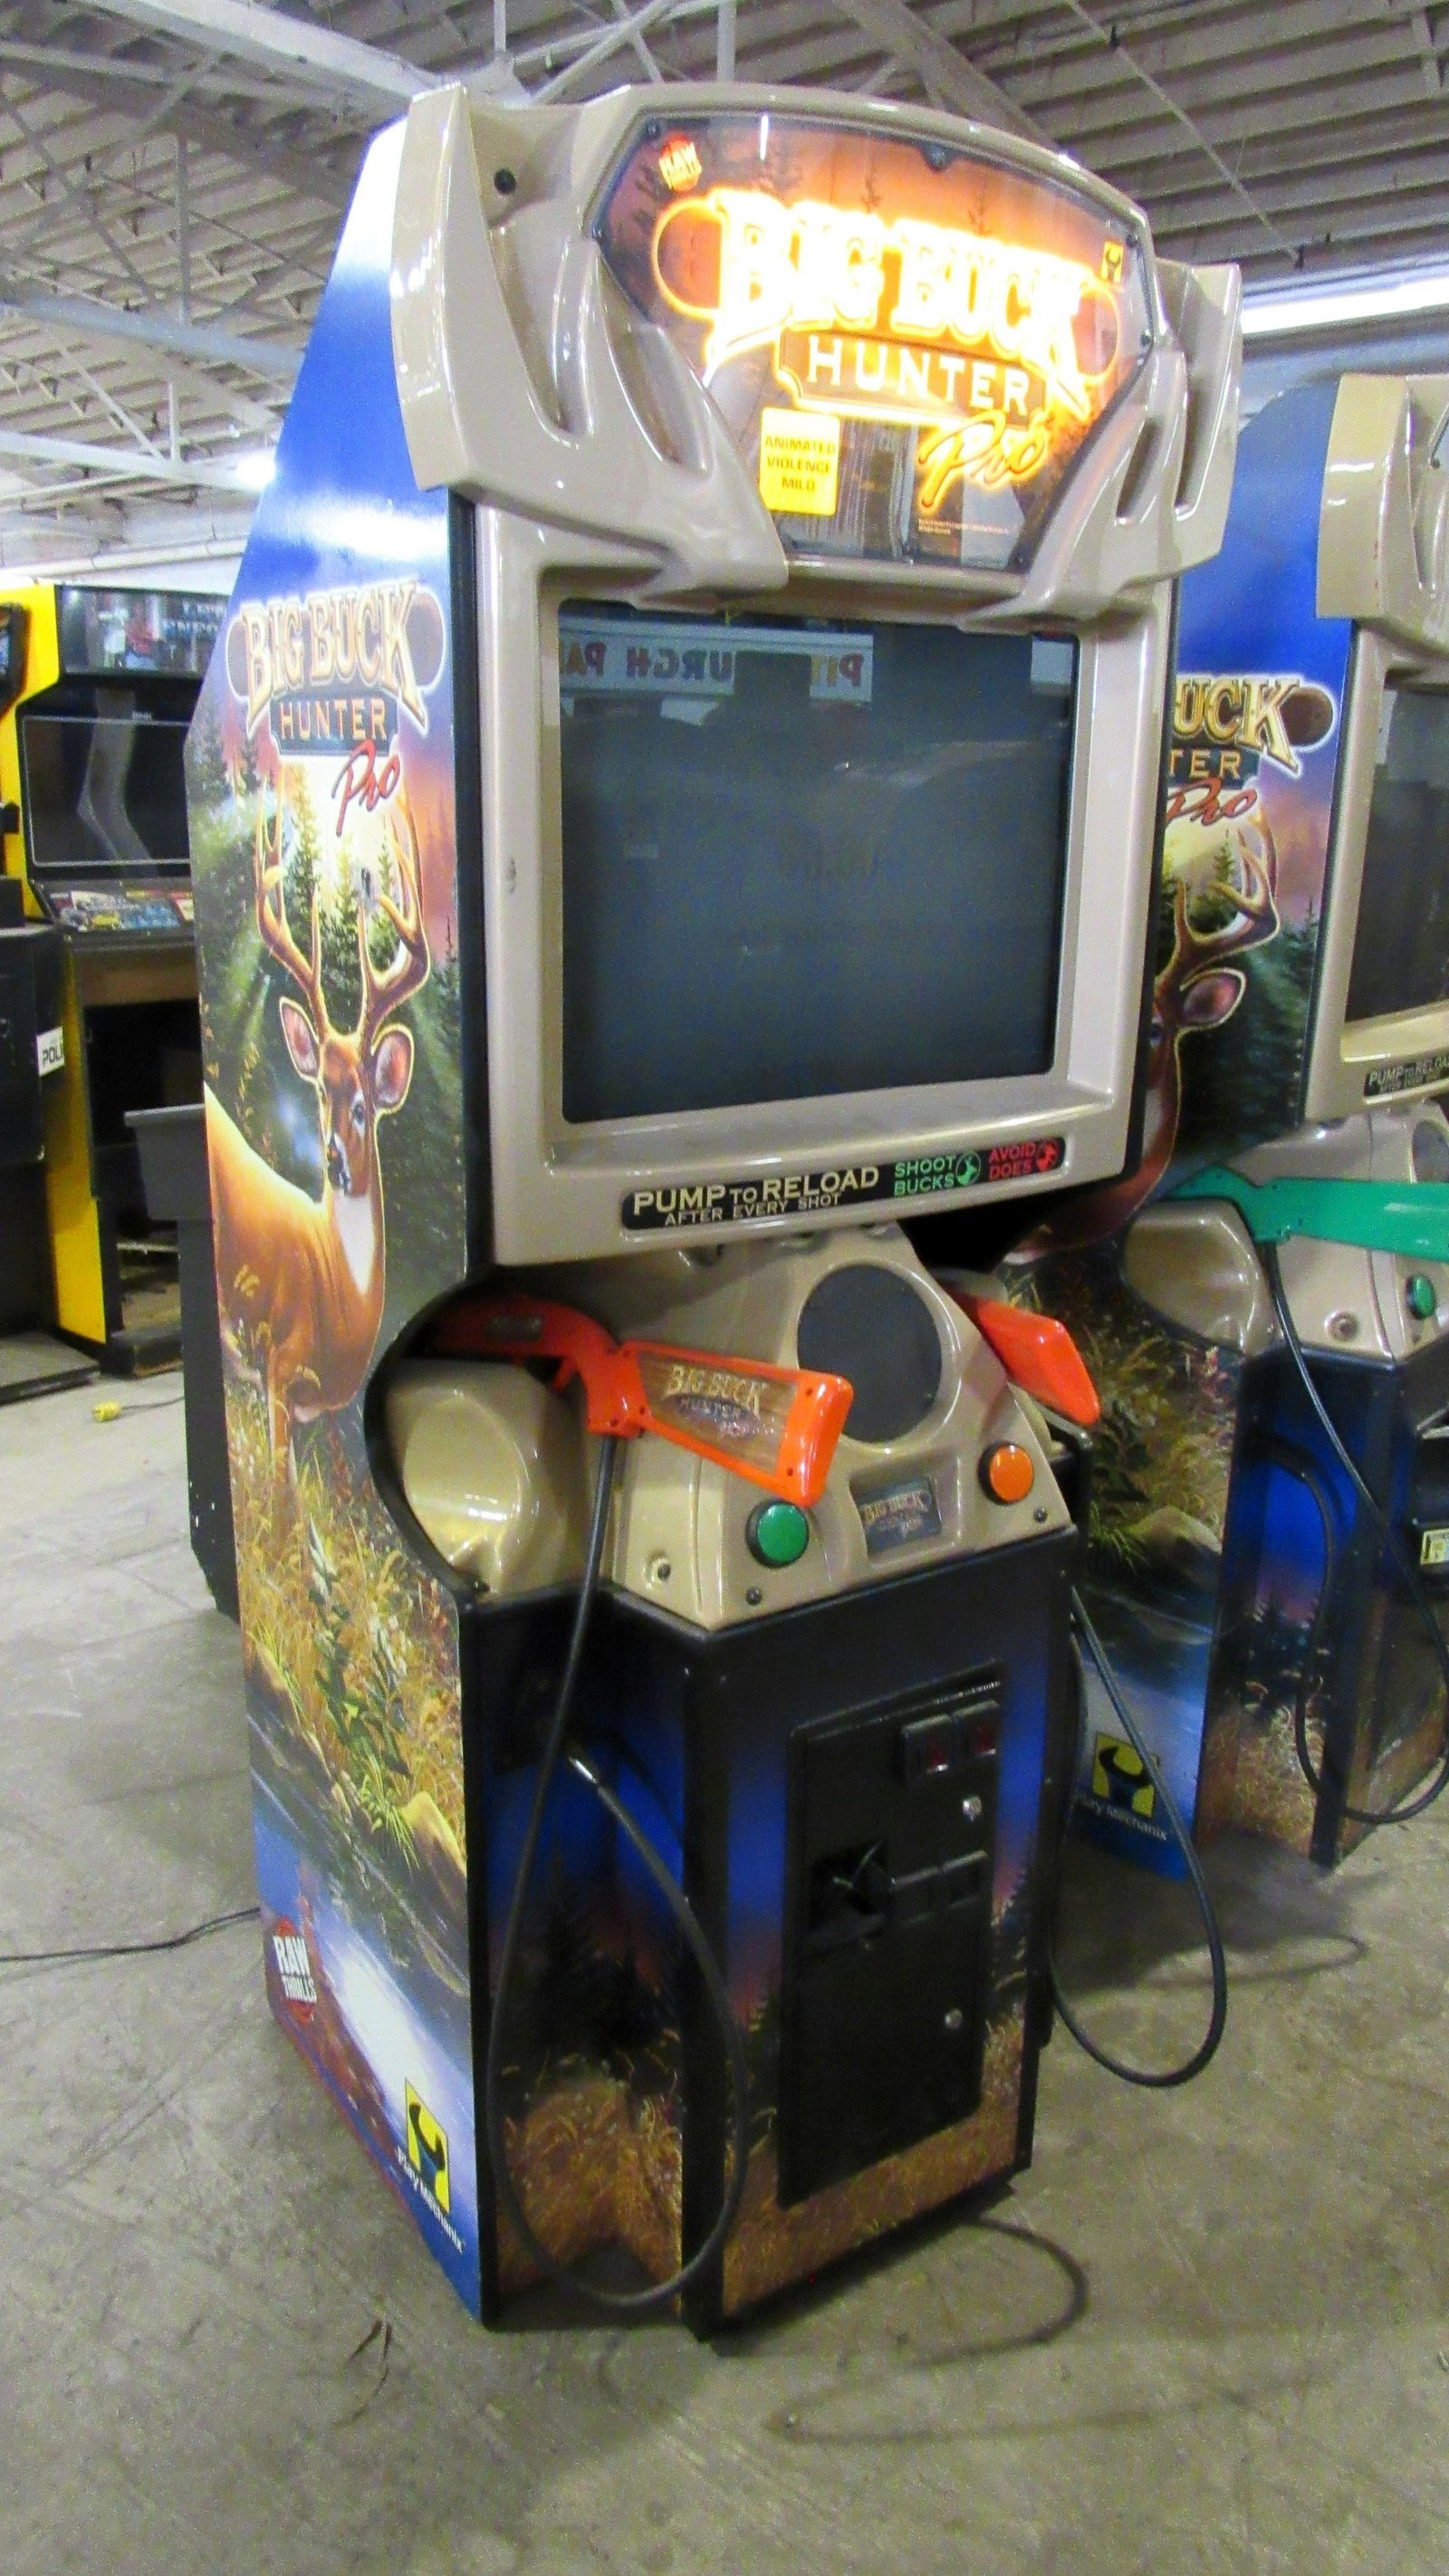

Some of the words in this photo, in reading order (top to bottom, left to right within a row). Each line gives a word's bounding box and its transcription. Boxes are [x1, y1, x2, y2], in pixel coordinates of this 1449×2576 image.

[708, 188, 884, 370] BIG
[891, 219, 1090, 418] BUCK
[807, 335, 1031, 417] HUNTER
[765, 436, 836, 455] ANIMATED
[916, 409, 1052, 509] Pro
[766, 456, 831, 475] VIOLENCE
[781, 476, 815, 492] MILD
[242, 594, 304, 730] BIG
[307, 580, 426, 730] BUCK
[278, 697, 388, 741] HUNTER
[331, 739, 400, 838] Pro
[895, 1154, 956, 1179] SHOOT
[988, 1141, 1037, 1165] AVOID
[989, 1159, 1033, 1182] DOES
[633, 1185, 726, 1216] PUMP
[730, 1187, 757, 1206] TO
[762, 1166, 879, 1202] RELOAD
[895, 1174, 955, 1198] BUCKS
[665, 1205, 724, 1227] AFTER
[733, 1198, 789, 1220] EVERY
[797, 1192, 841, 1212] SHOT
[272, 1934, 311, 1976] RAW
